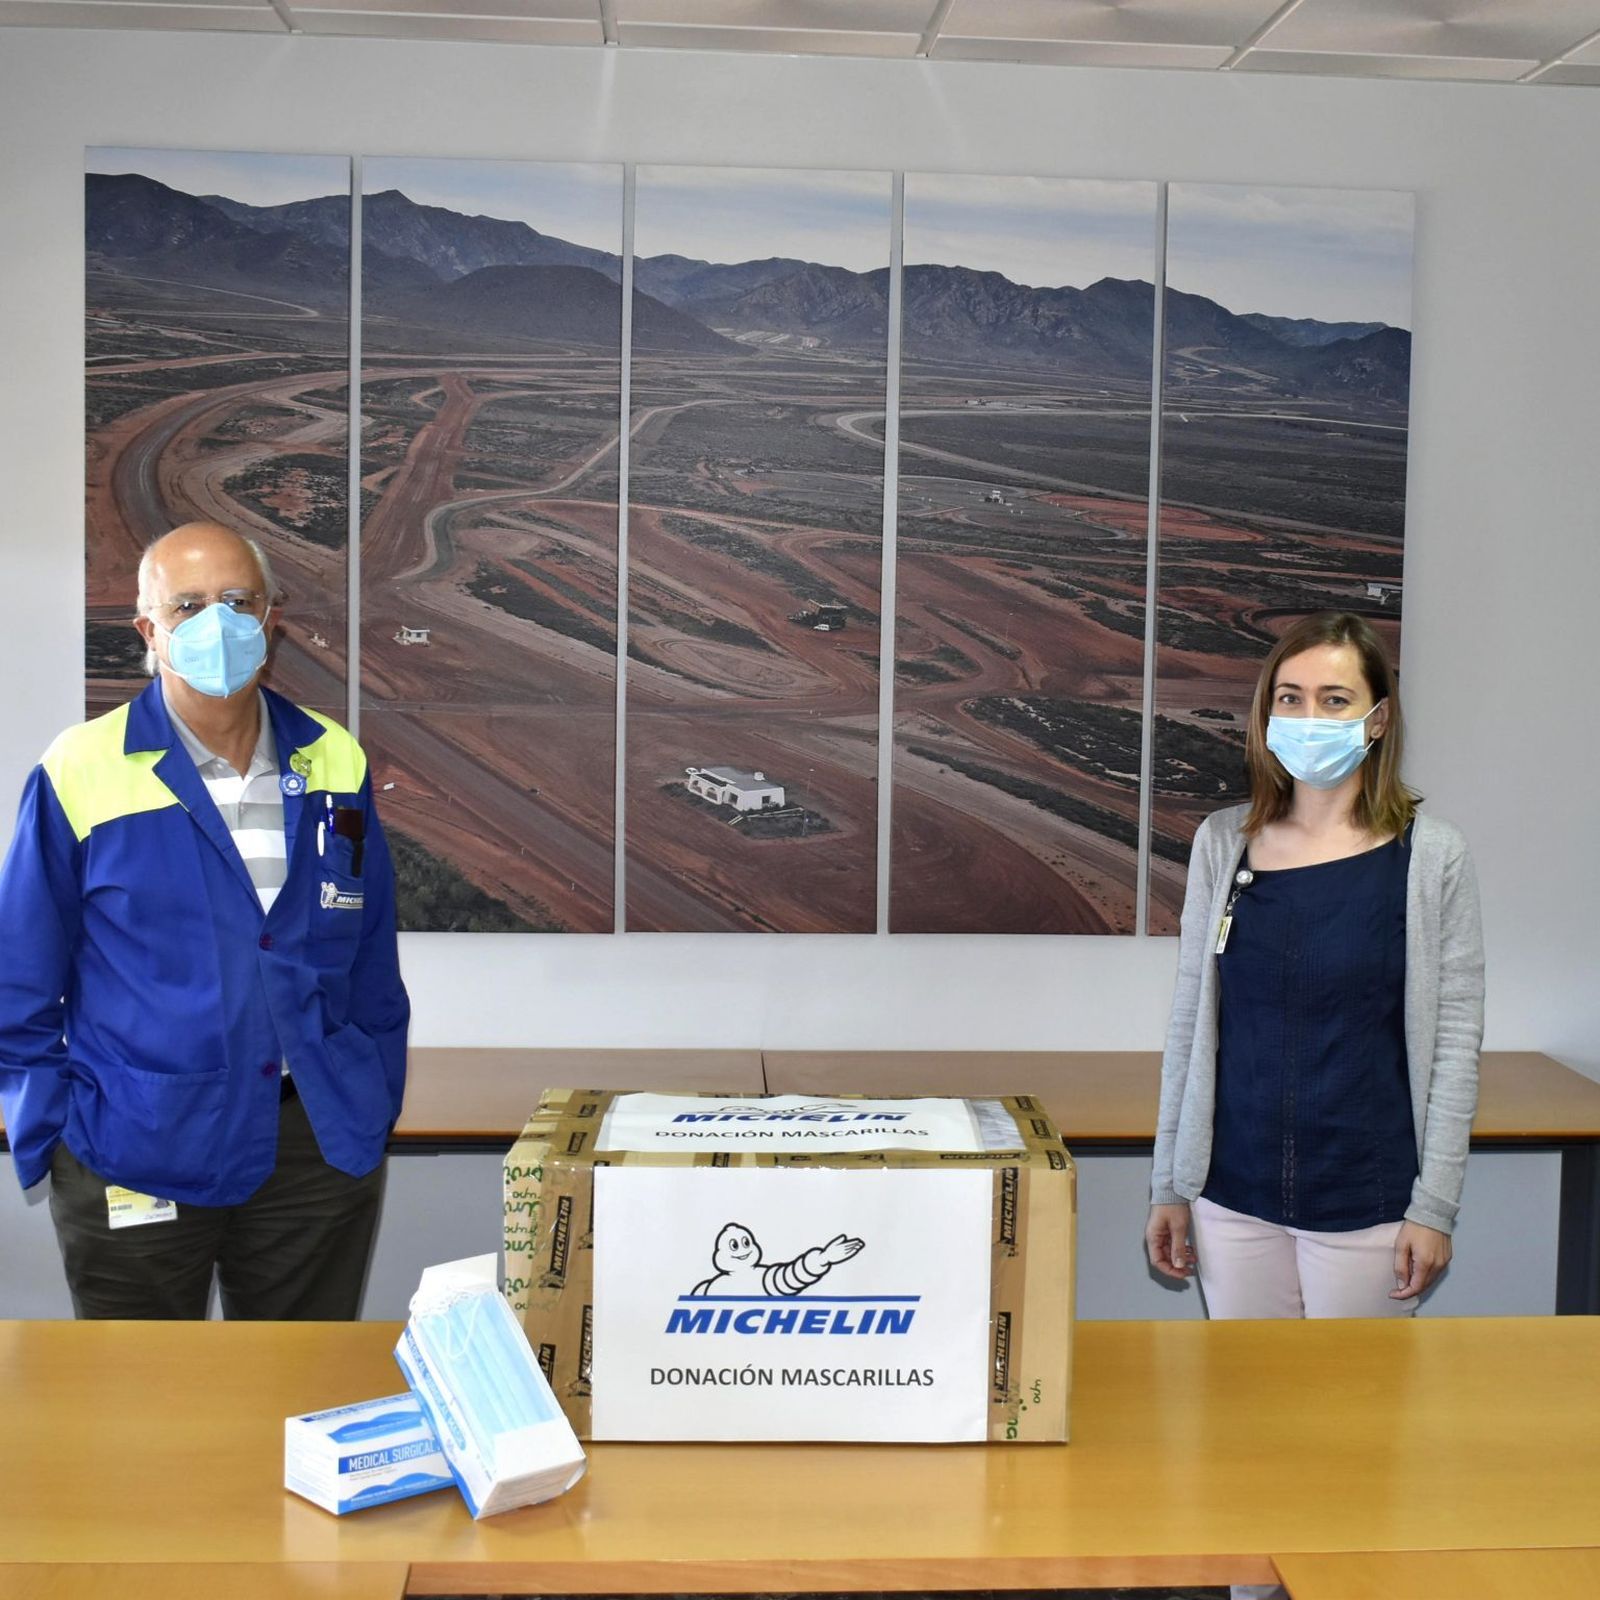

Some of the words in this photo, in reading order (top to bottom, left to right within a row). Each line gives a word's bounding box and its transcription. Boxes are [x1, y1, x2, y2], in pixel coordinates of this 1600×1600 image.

[672, 1113, 910, 1123] MICHELIN
[655, 1129, 773, 1138] DONACIÓN
[782, 1127, 929, 1138] MASCARILLAS
[1003, 1168, 1015, 1239] MICHELIN
[553, 1199, 570, 1271] MICHELIN
[665, 1309, 915, 1334] MICHELIN
[995, 1314, 1008, 1385] MICHELIN
[650, 1364, 773, 1386] DONACIÓN
[782, 1369, 934, 1386] MASCARILLAS
[349, 1452, 389, 1471] MEDICAL
[392, 1441, 434, 1462] SURGICAL
